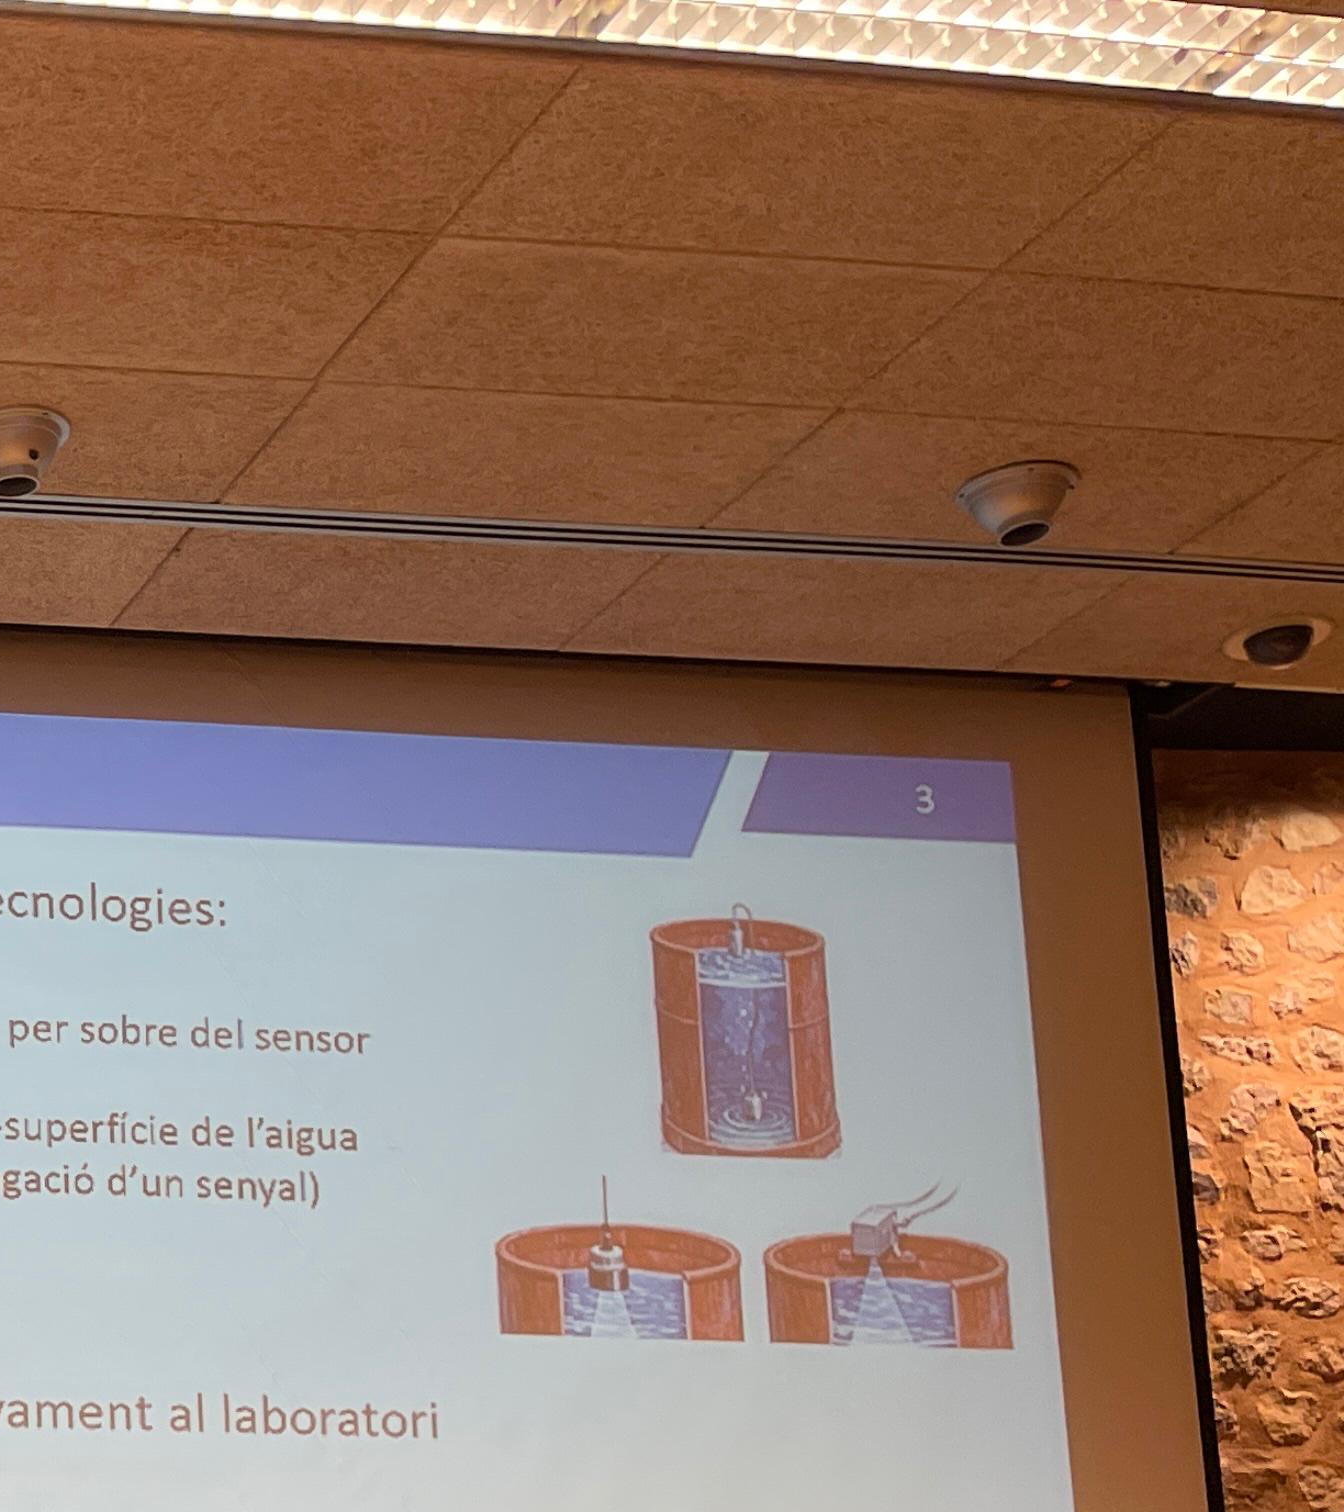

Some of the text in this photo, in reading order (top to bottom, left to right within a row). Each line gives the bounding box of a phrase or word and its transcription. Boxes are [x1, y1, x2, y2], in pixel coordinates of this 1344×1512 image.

[915, 784, 935, 814] 3
[8, 1019, 69, 1049] per
[80, 1014, 178, 1048] sobre
[190, 1016, 244, 1050] del
[255, 1028, 371, 1055] sensor
[191, 1115, 235, 1148] de
[196, 1170, 320, 1209] senyal)
[170, 1392, 204, 1433] al
[223, 1393, 438, 1439] laboratori
